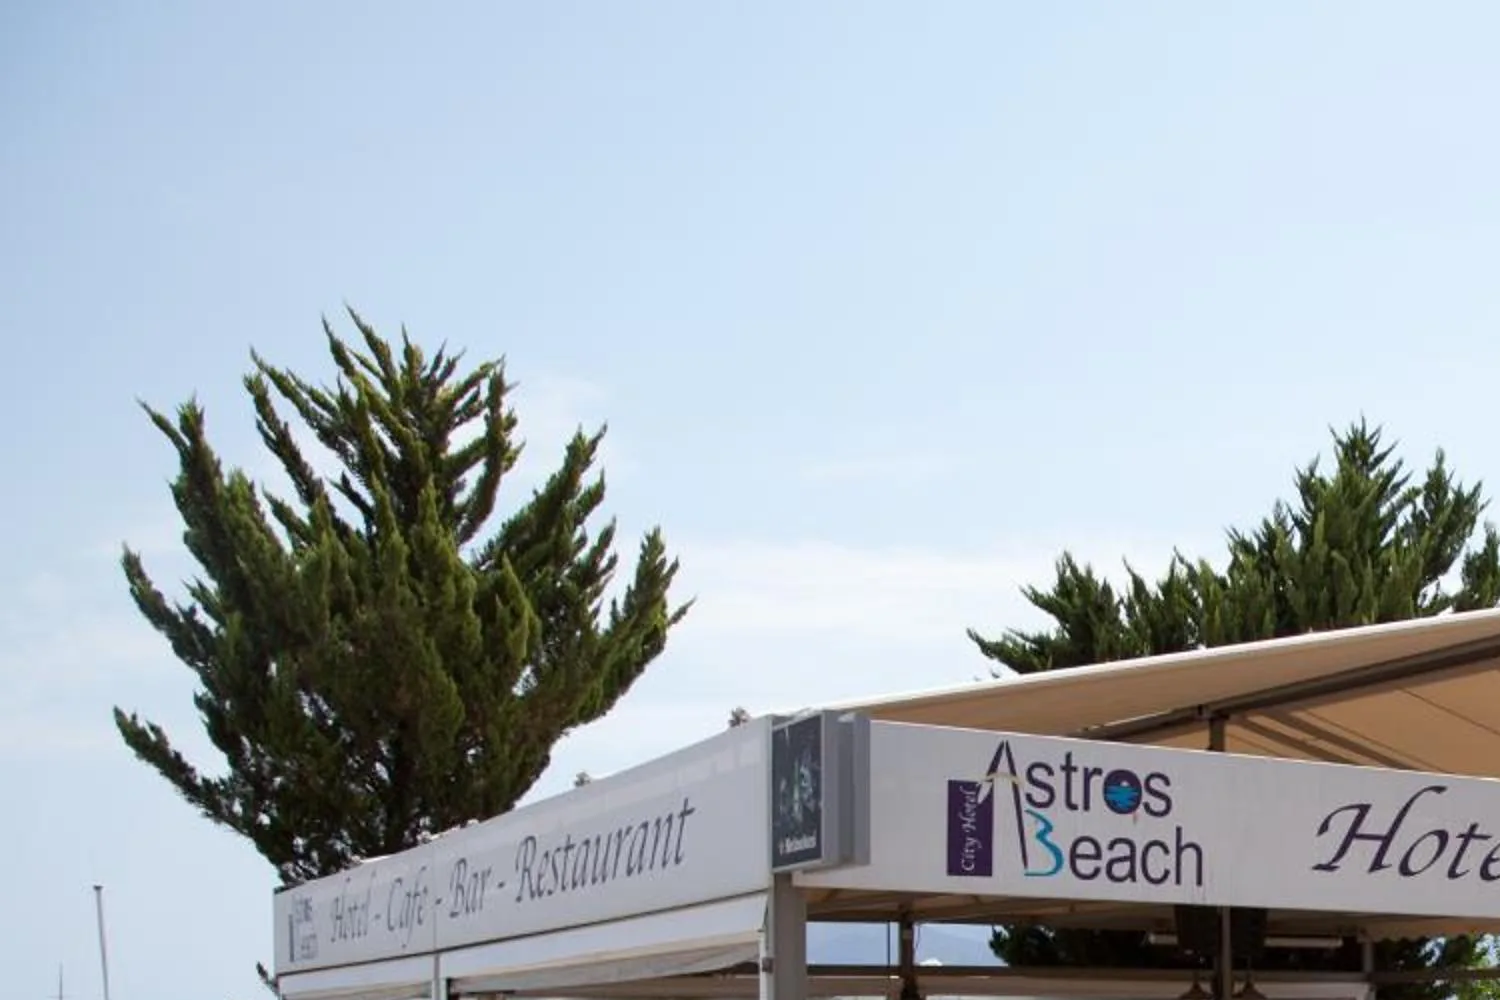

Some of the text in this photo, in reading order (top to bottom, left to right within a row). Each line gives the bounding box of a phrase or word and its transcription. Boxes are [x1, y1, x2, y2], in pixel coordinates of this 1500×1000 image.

[959, 784, 983, 872] City Hotel
[977, 740, 1174, 868] Astros
[1024, 809, 1204, 887] Beach
[449, 857, 492, 918] Bar
[514, 797, 695, 903] Restaurant
